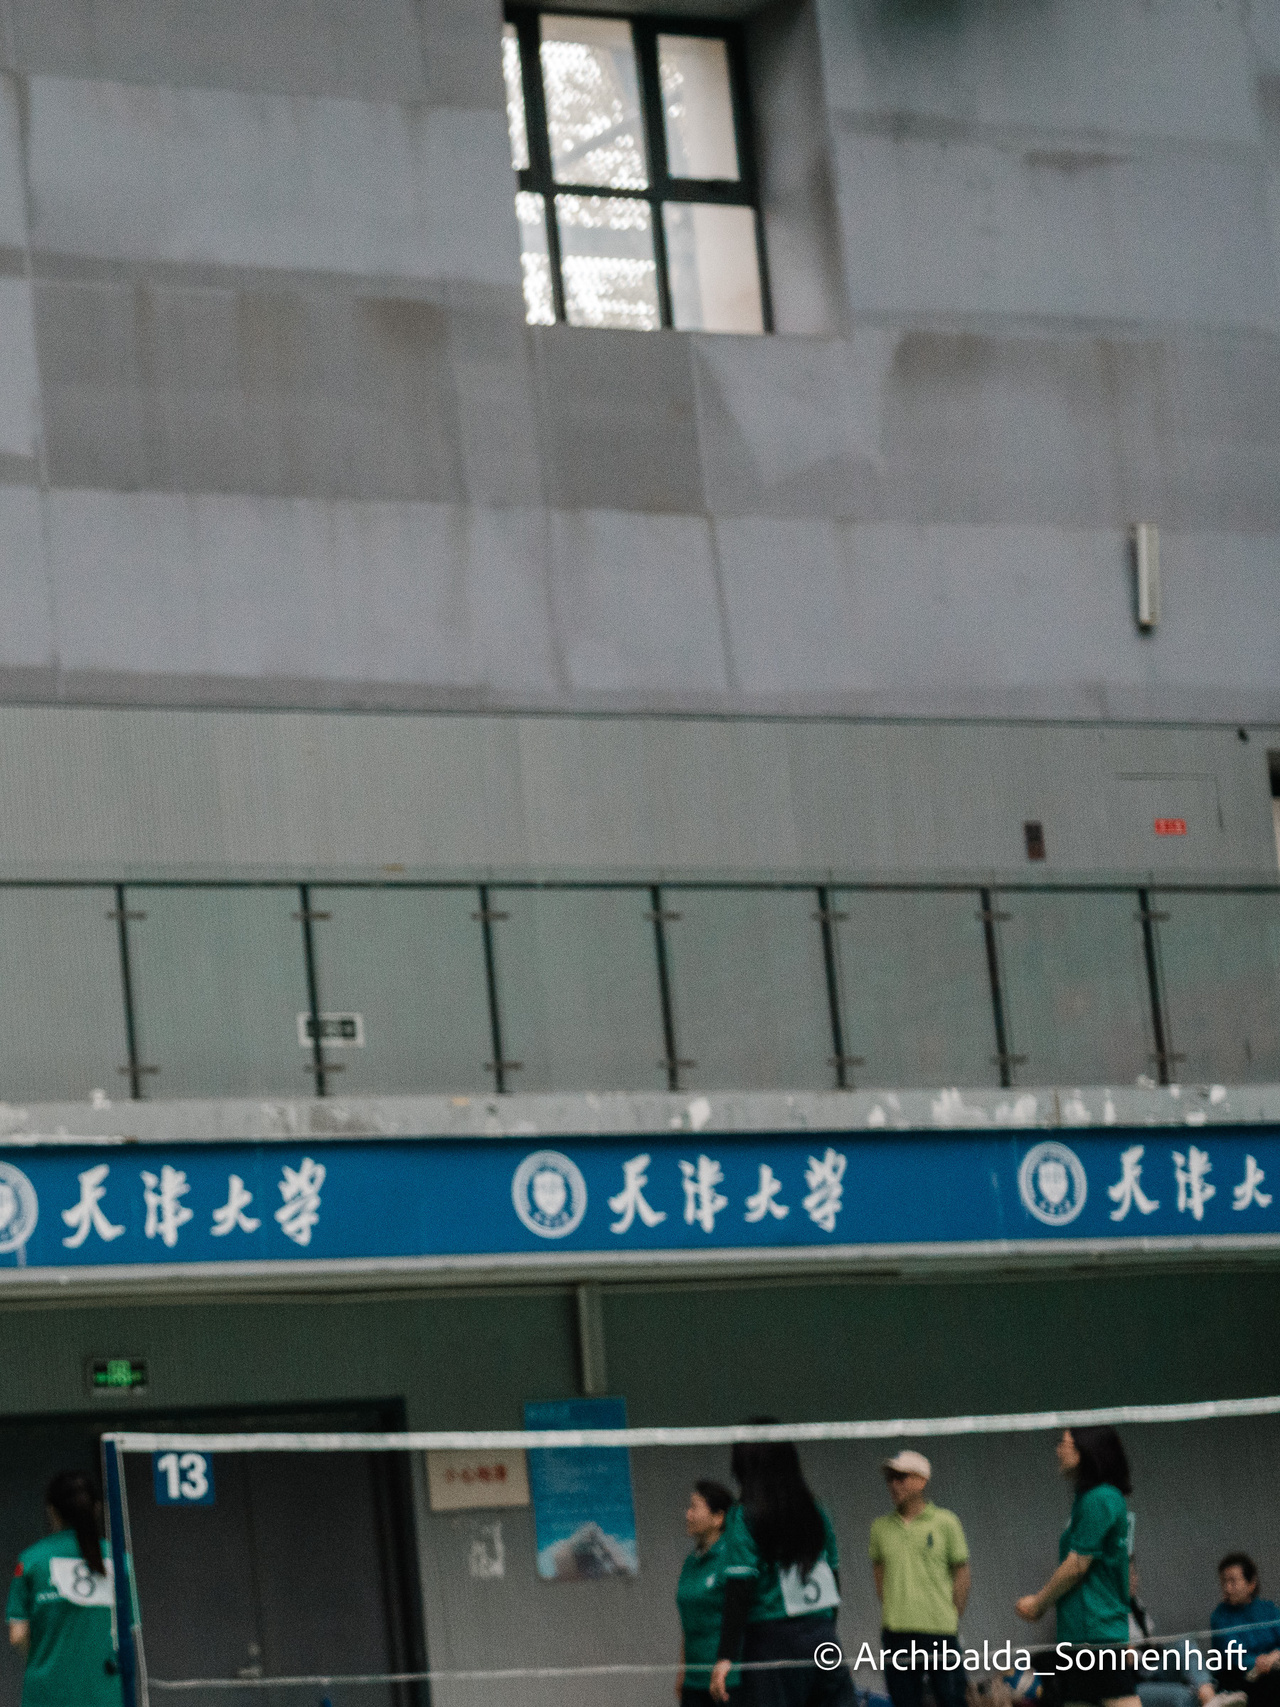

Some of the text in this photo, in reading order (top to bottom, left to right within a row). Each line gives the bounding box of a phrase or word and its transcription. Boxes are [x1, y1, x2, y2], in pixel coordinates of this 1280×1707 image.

[61, 1157, 326, 1248] 天津大学
[607, 1148, 847, 1234] 天津大学
[1108, 1144, 1273, 1222] 天津大
[157, 1452, 209, 1500] 13
[73, 1559, 96, 1598] 8
